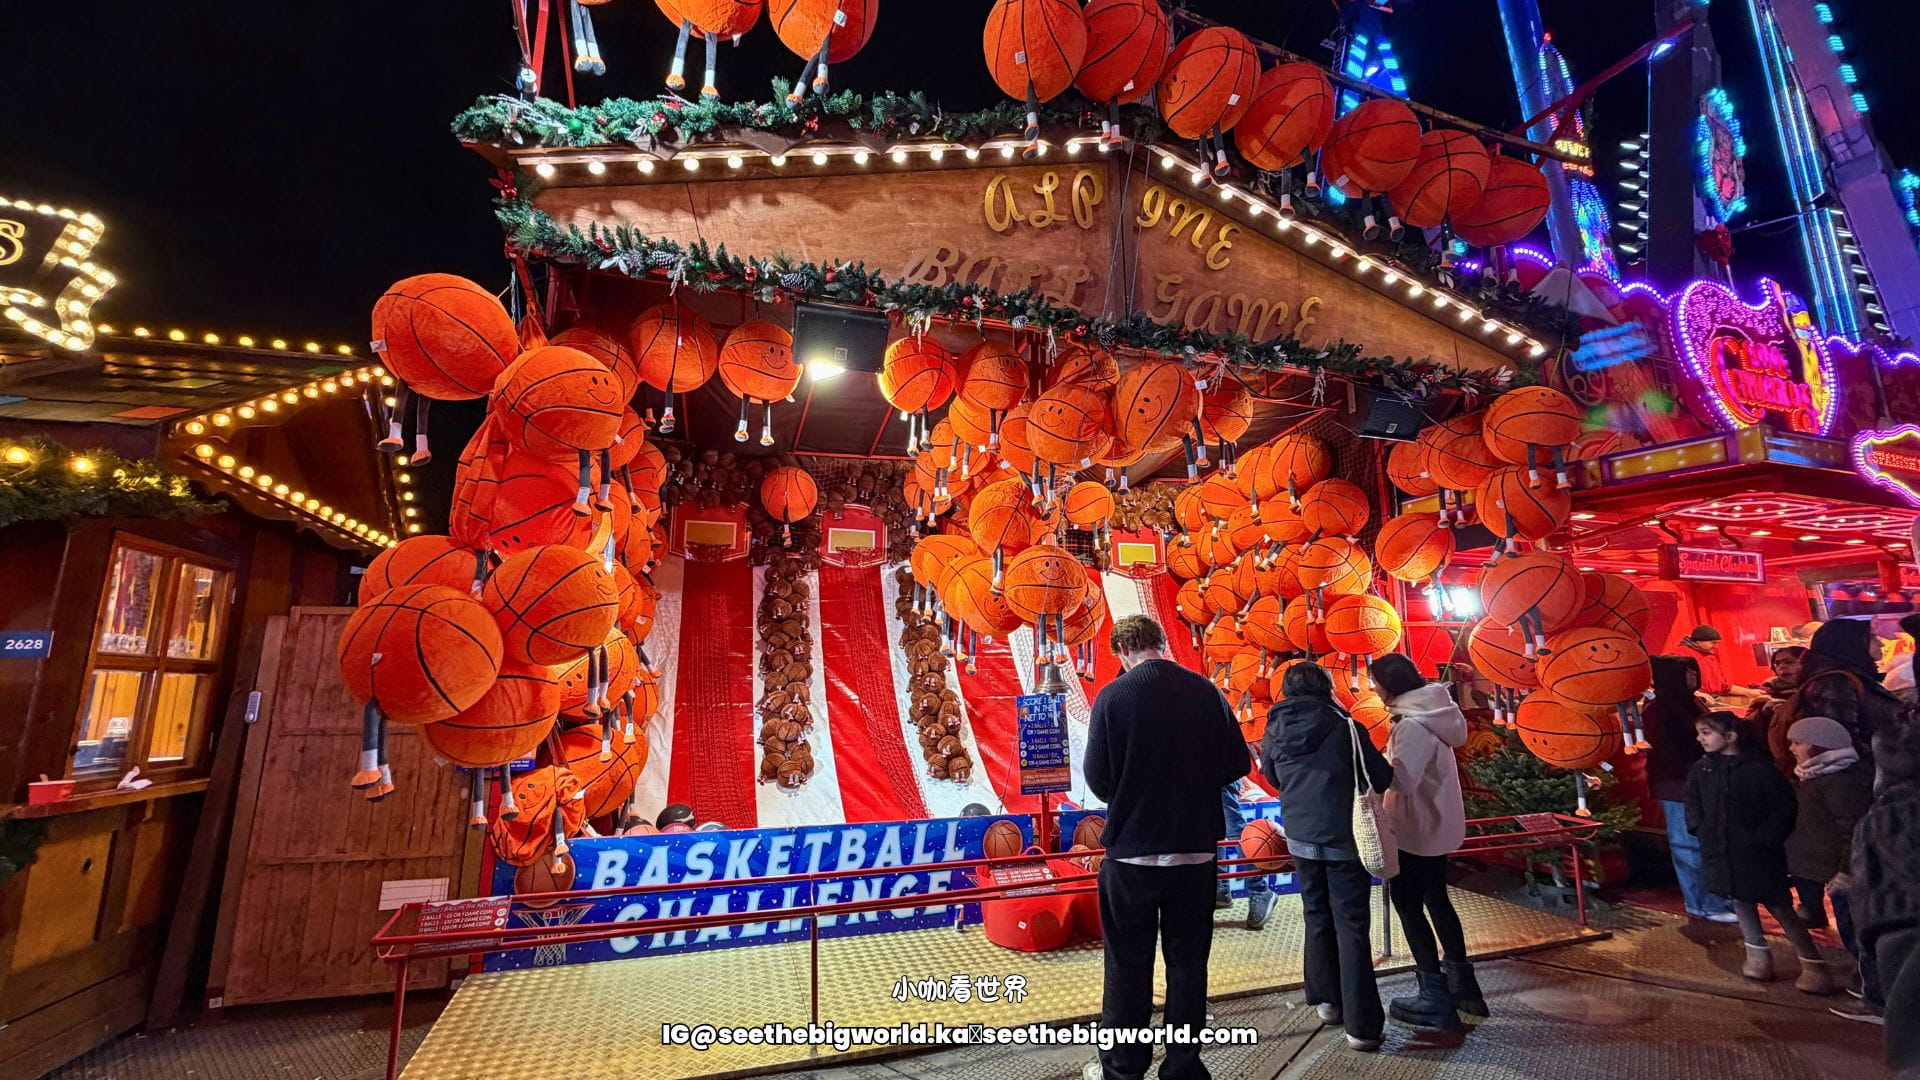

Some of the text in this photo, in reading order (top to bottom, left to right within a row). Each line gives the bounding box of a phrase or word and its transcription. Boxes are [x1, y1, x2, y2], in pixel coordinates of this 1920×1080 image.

[1146, 273, 1324, 346] GAME
[5, 639, 44, 650] 2628
[1037, 712, 1047, 720] TO
[585, 820, 967, 898] BASKETBALL
[608, 870, 953, 954] CHALLENGE
